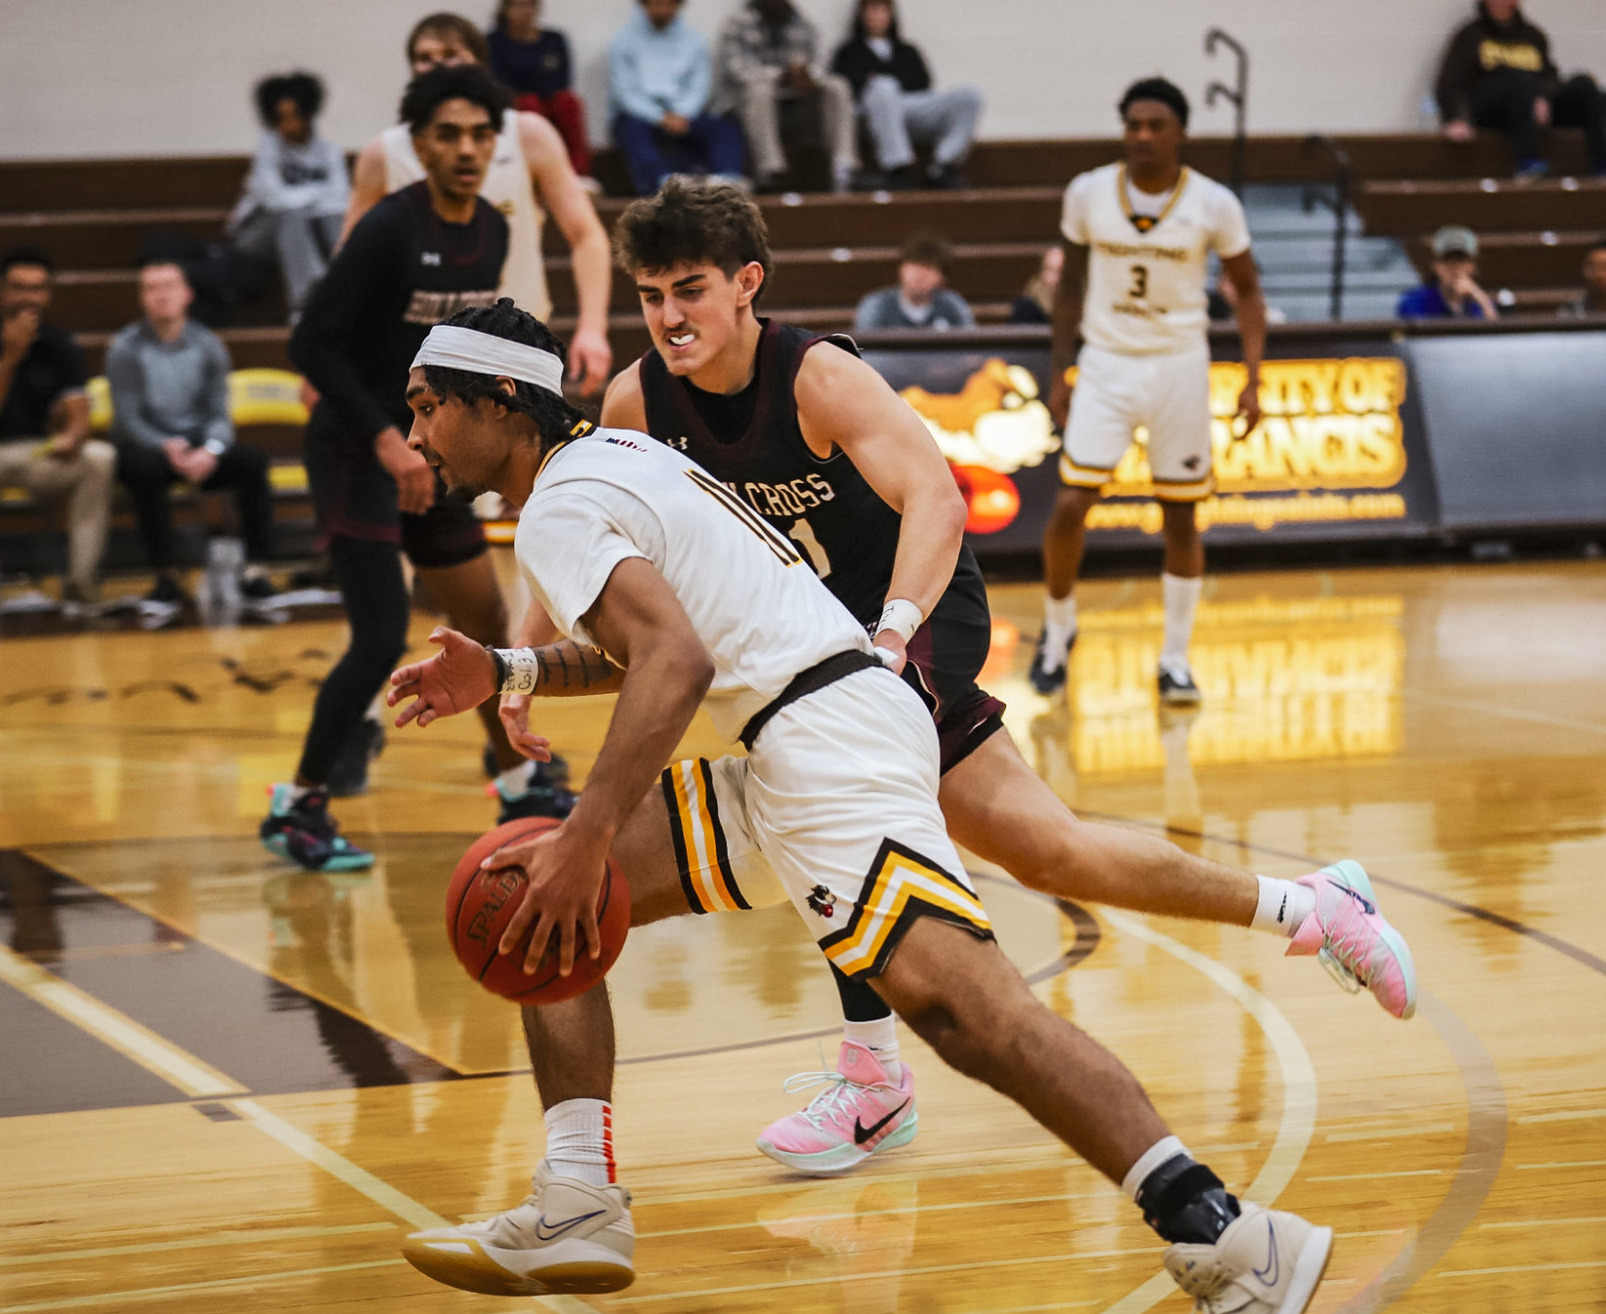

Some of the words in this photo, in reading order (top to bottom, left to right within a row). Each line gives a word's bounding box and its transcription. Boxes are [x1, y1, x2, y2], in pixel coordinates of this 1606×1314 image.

[1129, 265, 1148, 299] 3
[1342, 359, 1397, 413] OF
[744, 473, 836, 516] CROSS
[466, 871, 521, 948] SPALD
